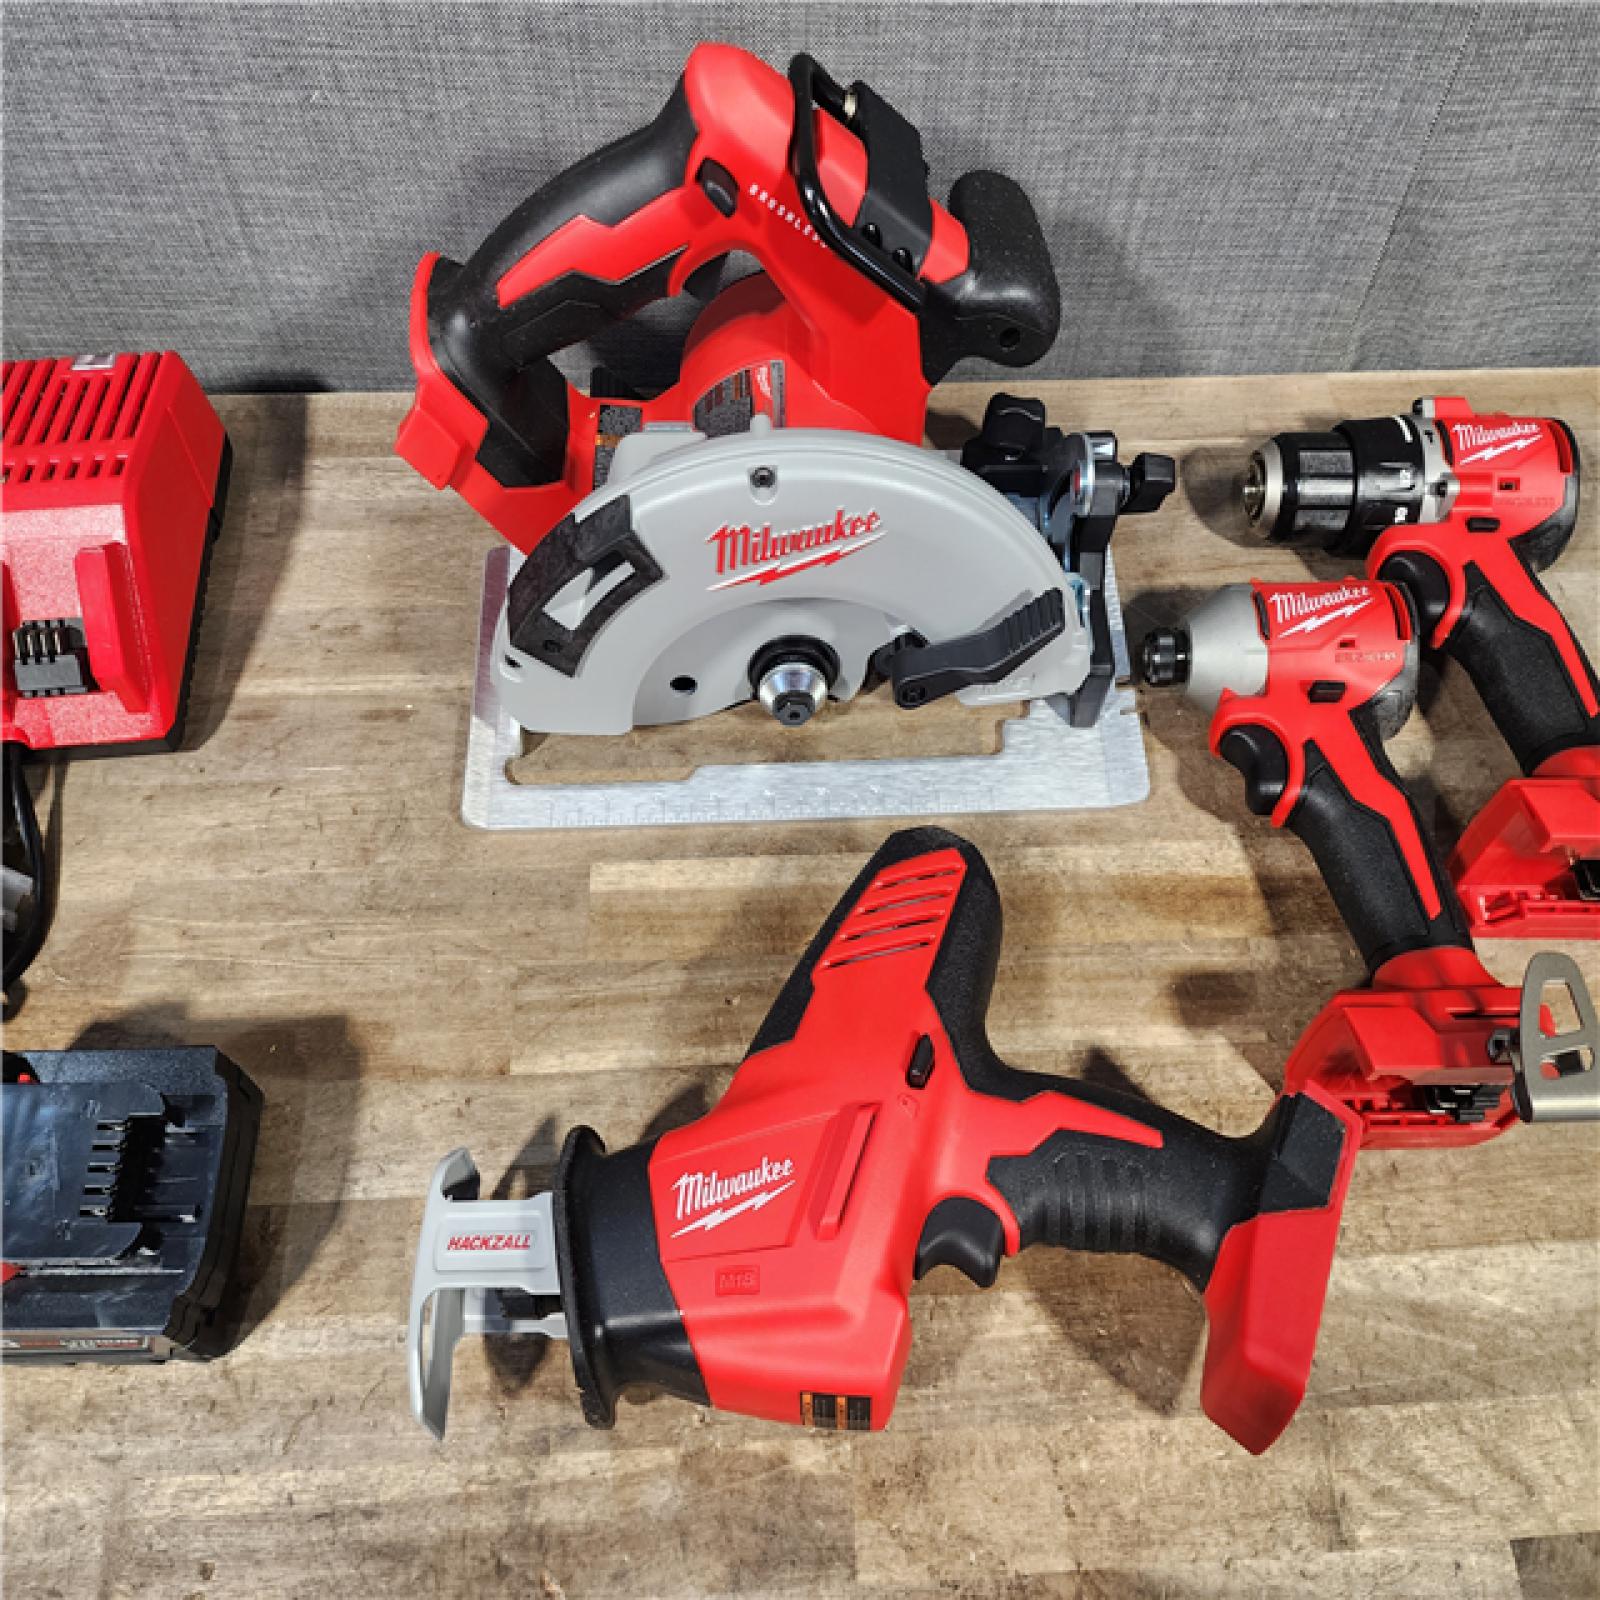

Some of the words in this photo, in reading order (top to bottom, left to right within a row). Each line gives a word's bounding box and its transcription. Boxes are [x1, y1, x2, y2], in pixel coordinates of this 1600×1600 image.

[1451, 421, 1542, 451] Milwaukee
[704, 505, 883, 576] Milwaukee
[1268, 584, 1370, 624] Milwaukee
[671, 1155, 794, 1221] Milwaukee
[447, 1232, 531, 1251] HACKZALL
